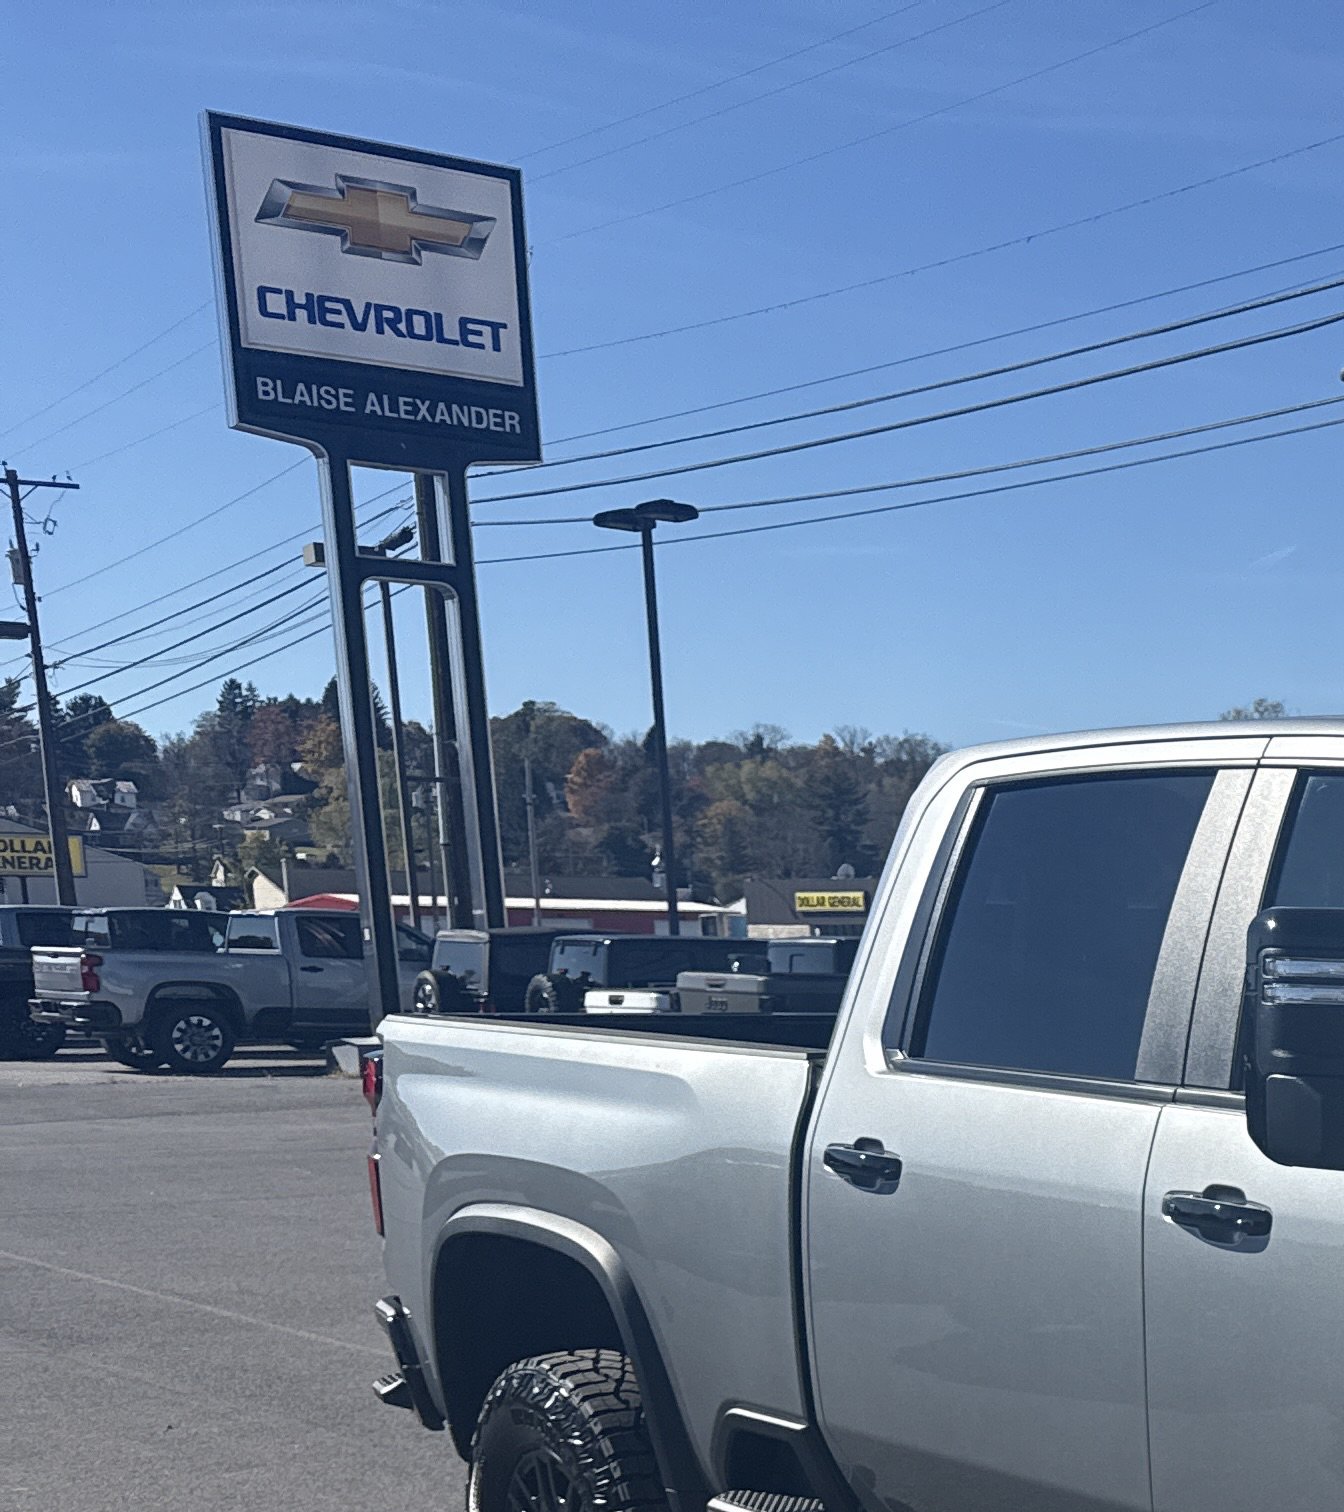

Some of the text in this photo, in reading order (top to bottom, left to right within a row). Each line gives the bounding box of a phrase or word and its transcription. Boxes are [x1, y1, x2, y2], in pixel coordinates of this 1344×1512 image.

[256, 285, 508, 352] CHEVROLET
[255, 376, 521, 434] BLAISE ALEXANDER
[0, 838, 53, 854] OLLA
[0, 855, 55, 870] NERA
